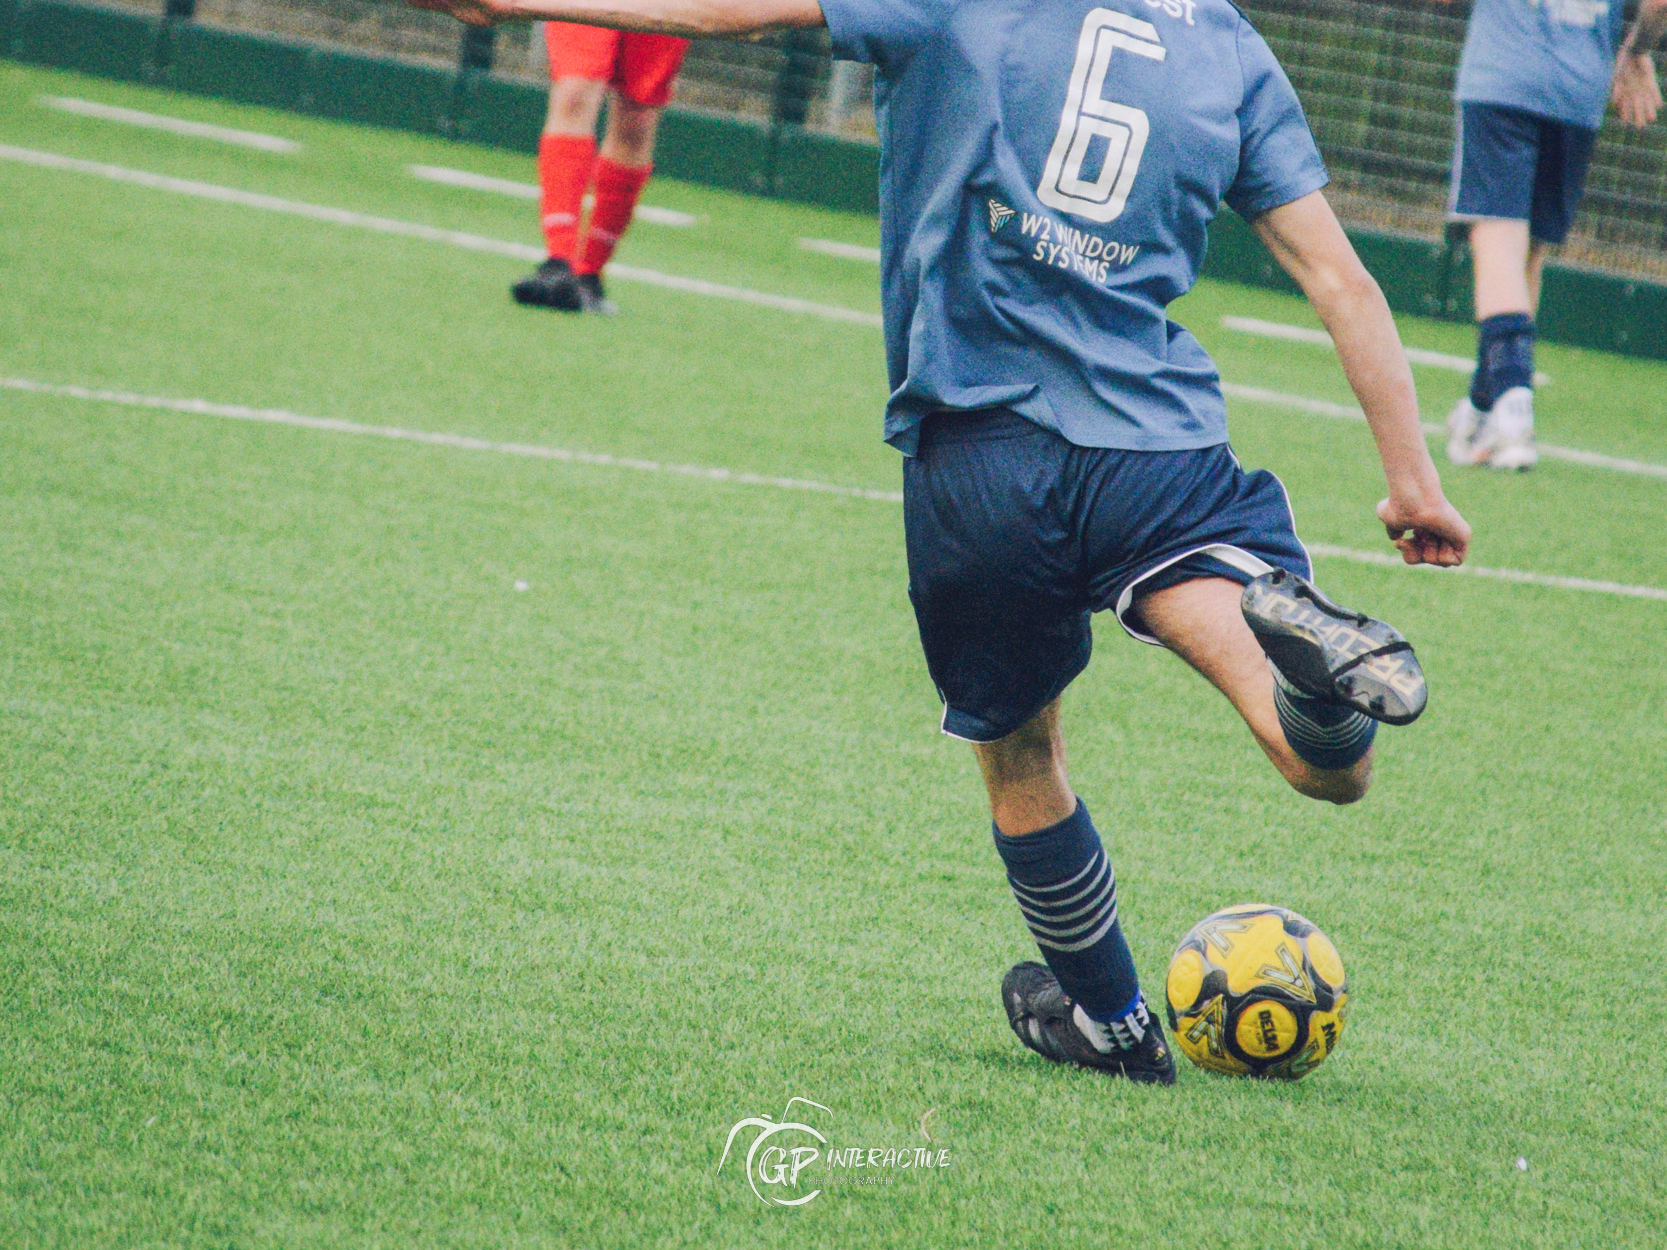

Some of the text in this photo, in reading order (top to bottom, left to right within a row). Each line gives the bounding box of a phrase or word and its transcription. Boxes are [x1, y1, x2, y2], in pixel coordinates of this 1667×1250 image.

[1036, 7, 1167, 223] 6
[1021, 212, 1140, 265] W2 WINDOW
[1033, 240, 1110, 283] SYSTEMS
[1258, 1010, 1280, 1052] DELTA
